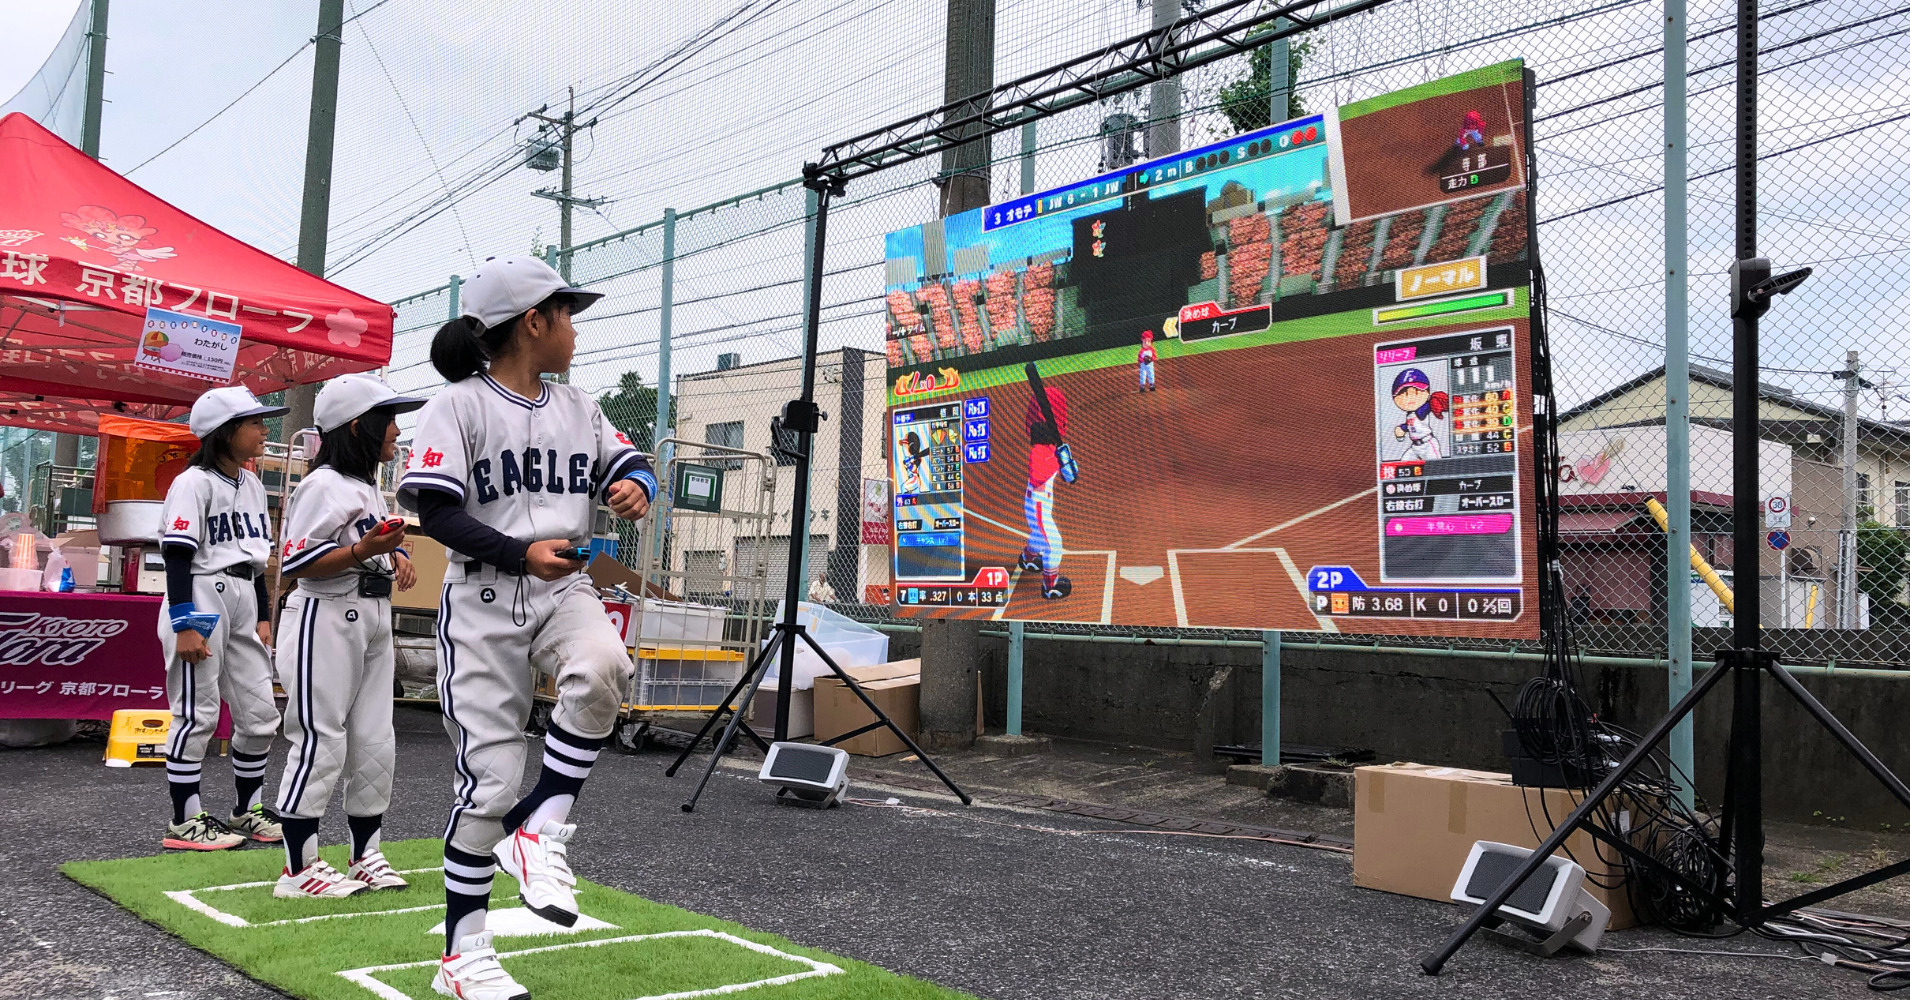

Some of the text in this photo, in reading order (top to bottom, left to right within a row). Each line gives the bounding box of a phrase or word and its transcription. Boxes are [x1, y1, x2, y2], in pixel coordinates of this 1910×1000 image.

[1185, 161, 1193, 174] B
[1237, 146, 1245, 159] S
[1447, 174, 1478, 190] 走力 D
[1005, 204, 1033, 221] オモテ
[1410, 266, 1474, 292] ノーマル
[0, 250, 314, 334] 球 京都フローラ
[1183, 307, 1210, 320] 決め球
[194, 338, 228, 351] わたがし
[1380, 349, 1410, 361] リリーフ
[471, 446, 599, 506] EAGLES
[1385, 496, 1511, 511] 右投右打 オーバースロー
[173, 516, 190, 530] 知
[986, 572, 1003, 585] 1P
[1316, 571, 1344, 588] 2P
[900, 590, 907, 601] 7
[930, 591, 947, 602] .327
[957, 591, 962, 601] 0
[968, 591, 976, 602] 本
[981, 592, 992, 602] 33
[1316, 595, 1328, 611] P
[1352, 595, 1366, 611] 防
[1372, 597, 1404, 611] 3.68
[1416, 598, 1427, 611] K
[1438, 598, 1448, 612] 0
[1468, 599, 1478, 612] 0
[60, 681, 164, 699] 京都フローラ
